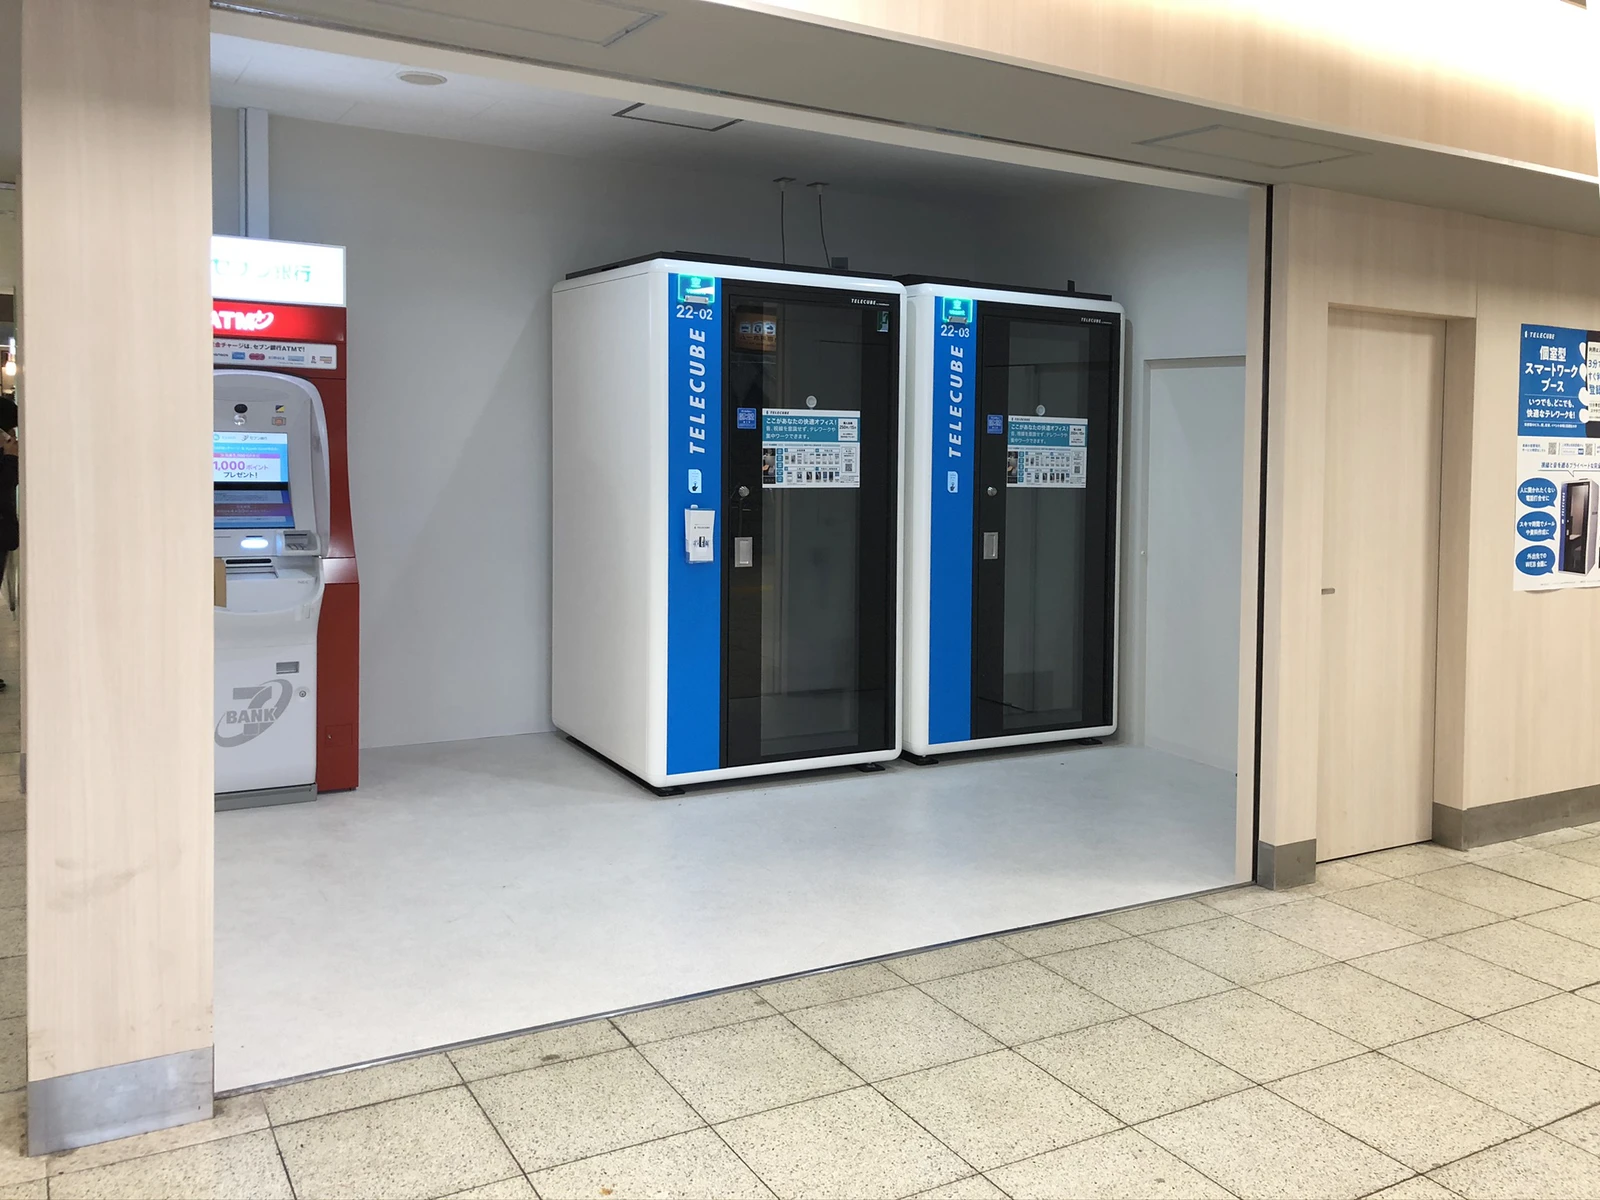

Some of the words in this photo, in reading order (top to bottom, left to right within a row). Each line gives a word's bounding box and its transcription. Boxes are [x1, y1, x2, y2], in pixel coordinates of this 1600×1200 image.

[676, 304, 713, 320] 22-02
[940, 324, 970, 338] 22-03
[1529, 331, 1555, 340] TELECUBE
[213, 342, 306, 353] 金チャージは、セブン銀行ATMで!
[1540, 345, 1567, 362] 個室型
[1525, 362, 1578, 378] スマートワーク
[689, 328, 706, 454] TELECUBE
[1541, 378, 1565, 392] ブース
[949, 345, 964, 458] TELECUBE
[223, 471, 258, 479] プレゼント!
[226, 708, 276, 724] BANK
